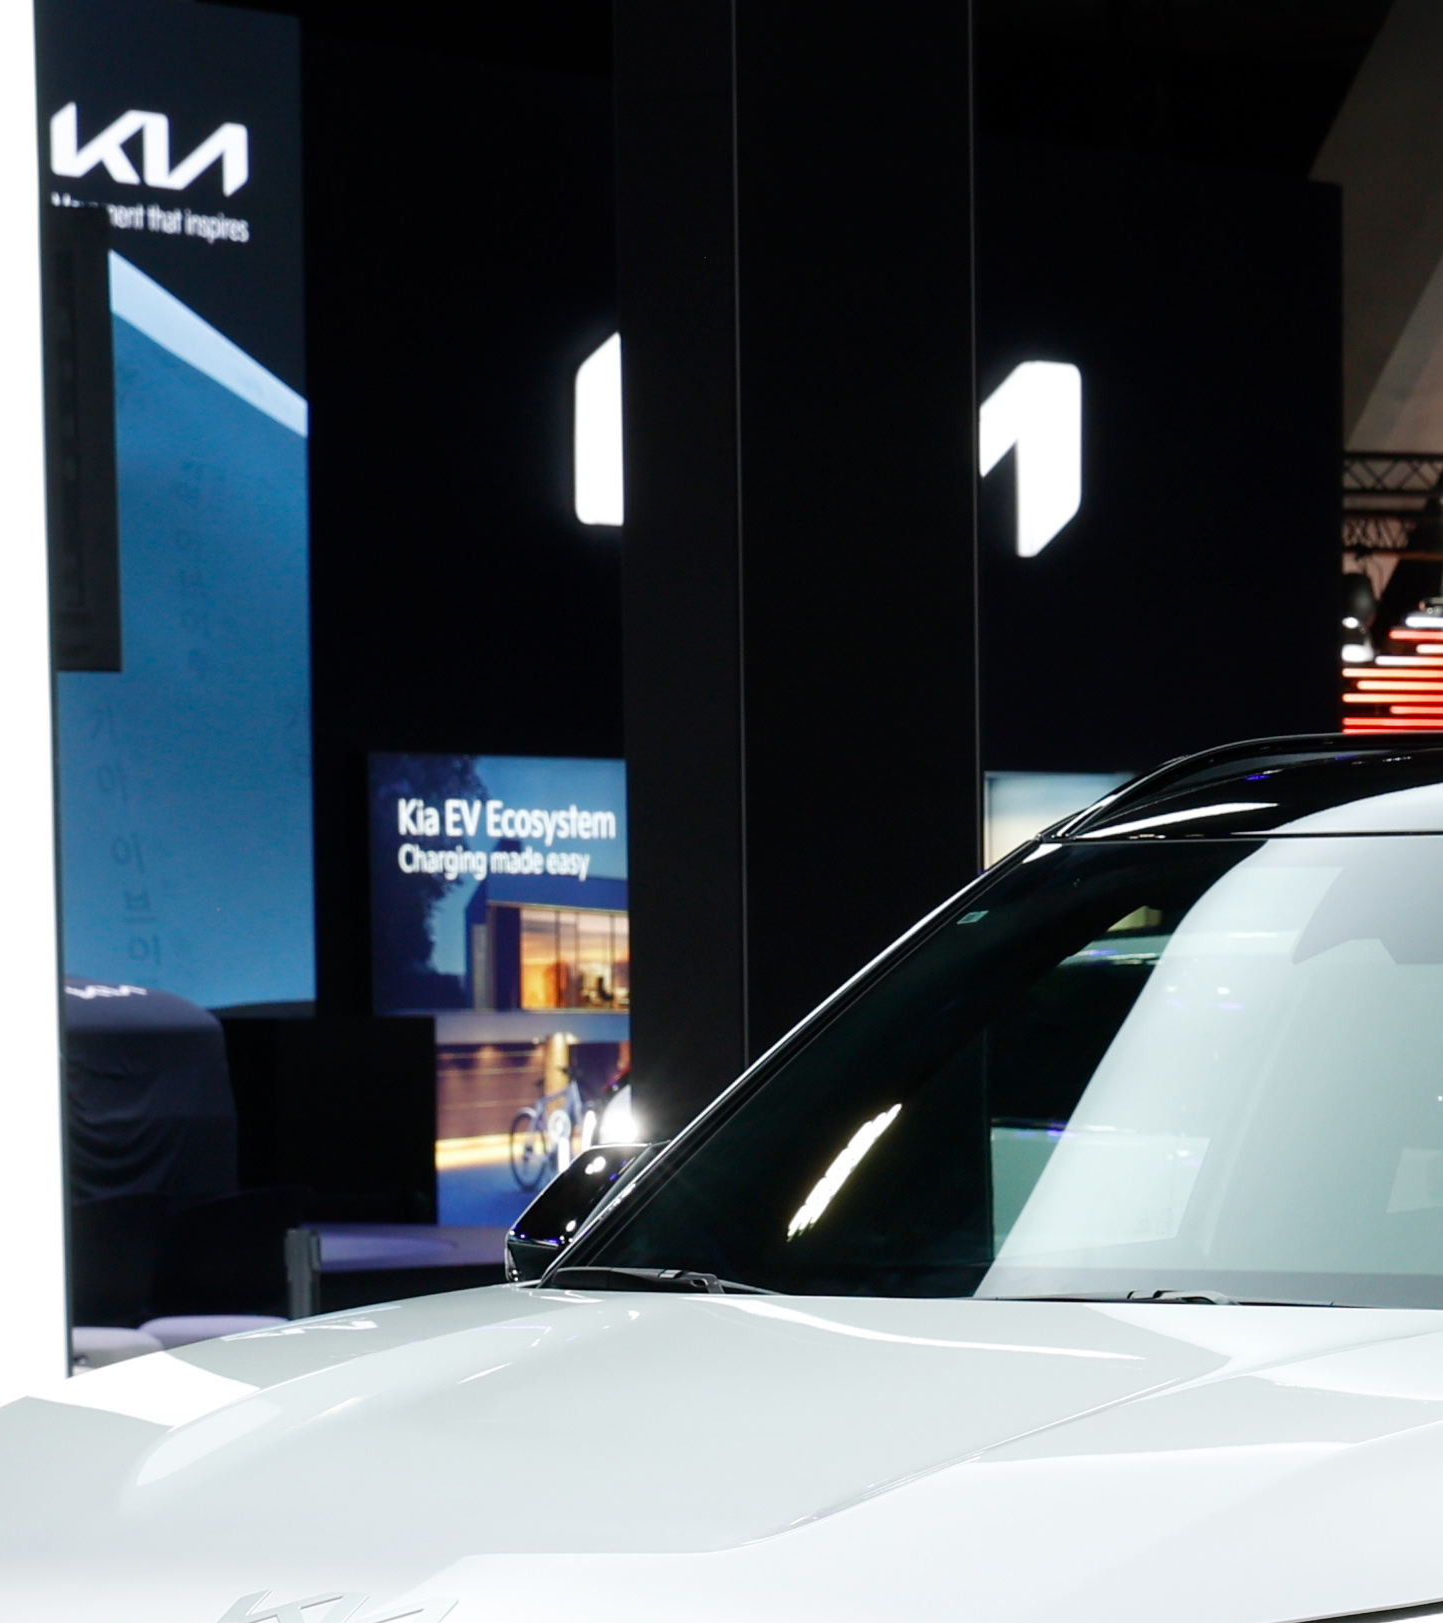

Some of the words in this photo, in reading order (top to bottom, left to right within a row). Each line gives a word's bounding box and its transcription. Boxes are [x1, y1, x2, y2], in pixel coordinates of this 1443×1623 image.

[146, 203, 182, 234] that
[184, 207, 249, 244] inspires
[397, 797, 440, 837] Kia
[444, 798, 482, 837] EV
[485, 799, 617, 847] Ecosystem
[397, 842, 488, 881] Charging
[490, 846, 544, 876] made
[546, 852, 591, 882] easy
